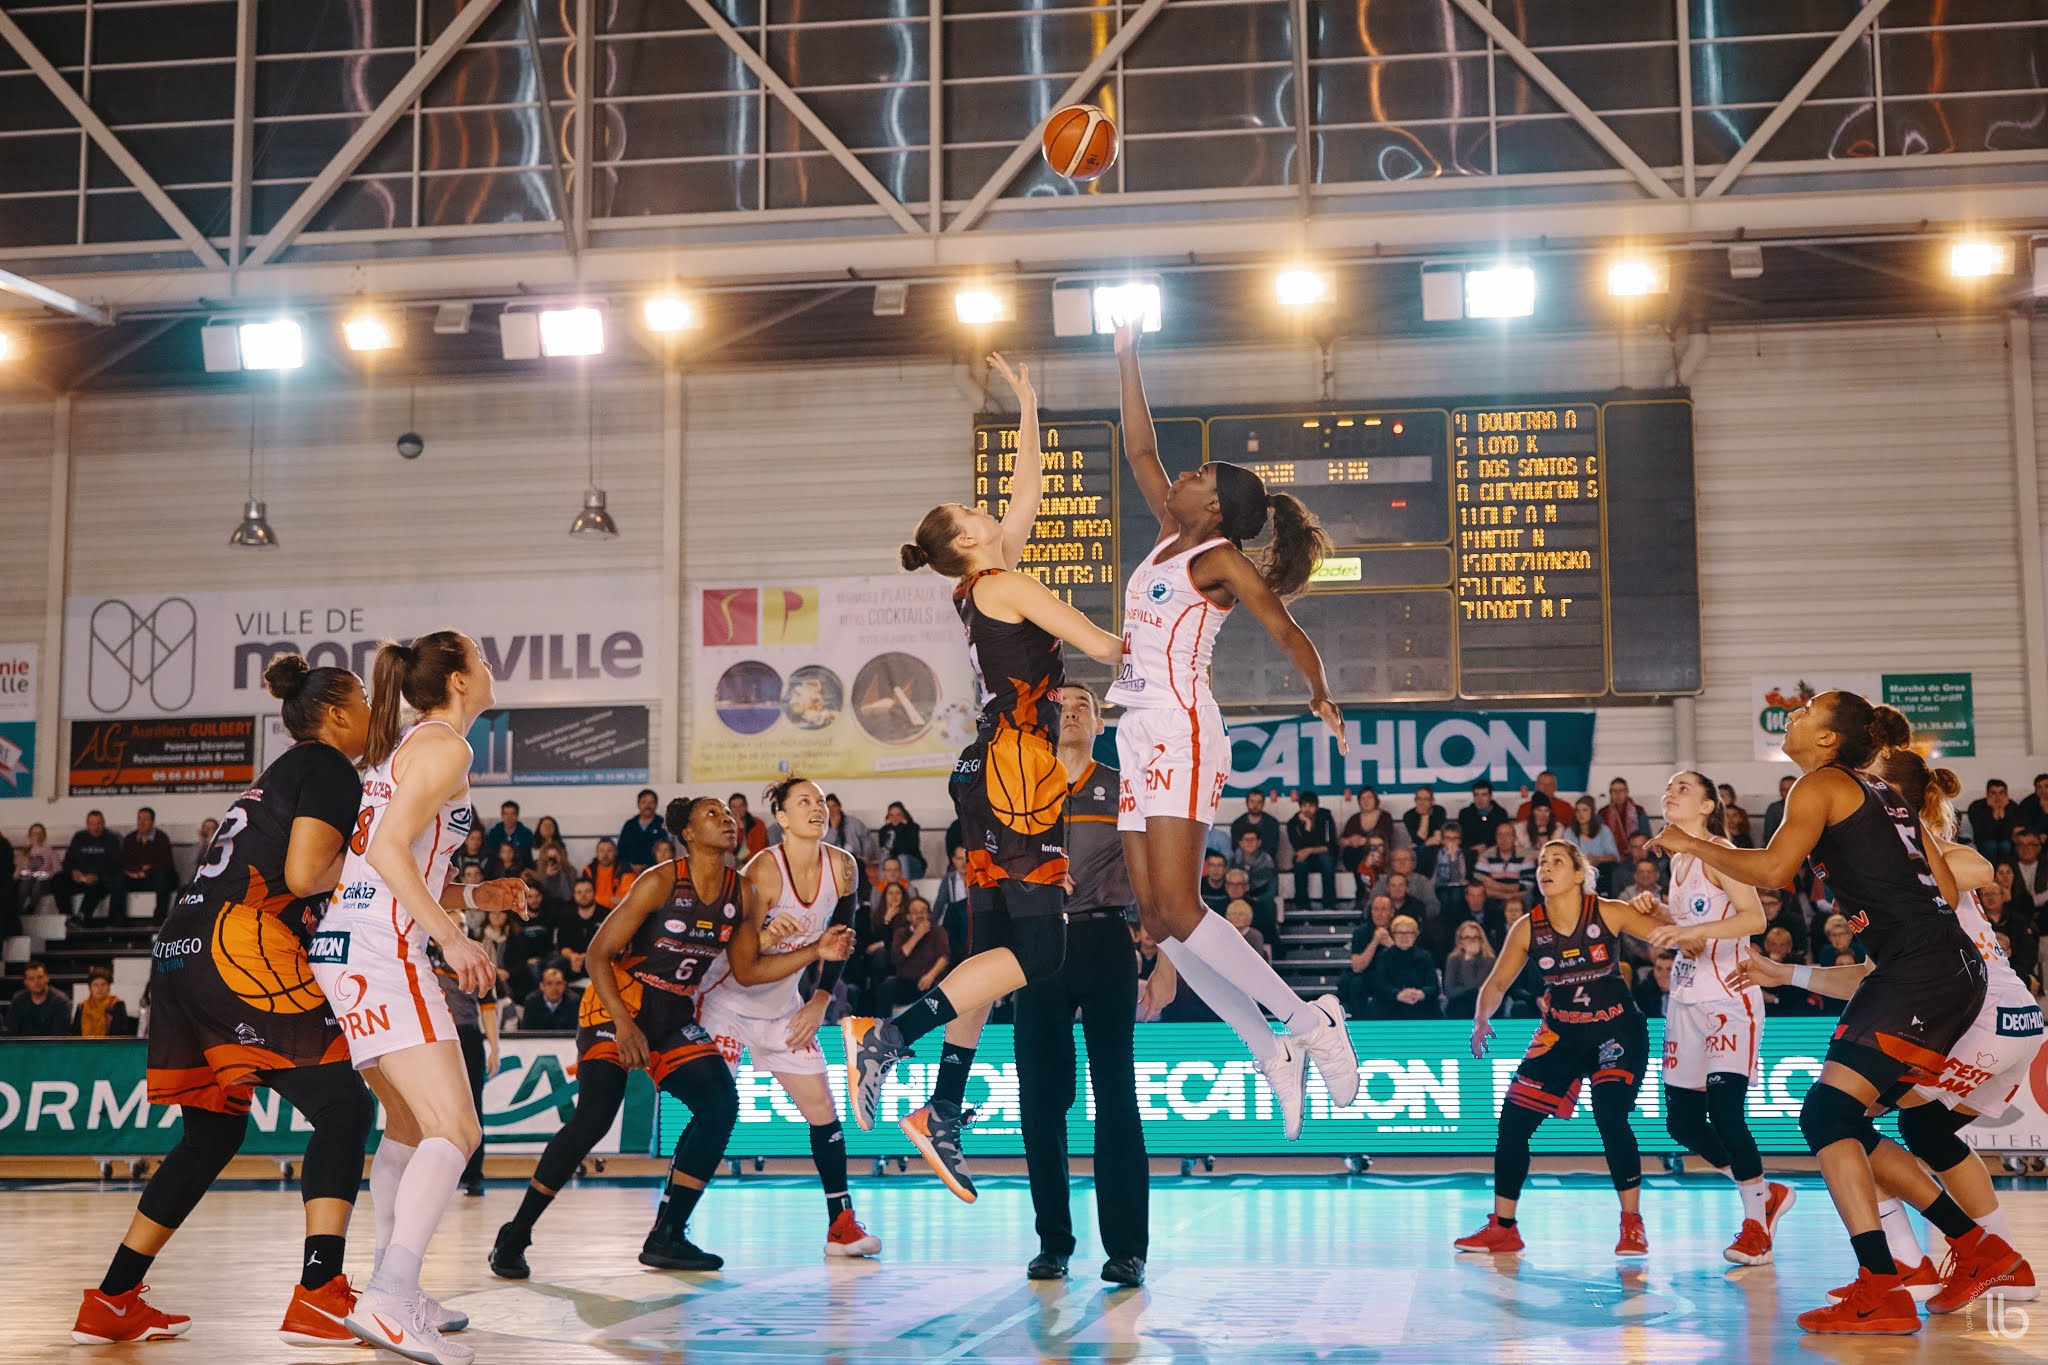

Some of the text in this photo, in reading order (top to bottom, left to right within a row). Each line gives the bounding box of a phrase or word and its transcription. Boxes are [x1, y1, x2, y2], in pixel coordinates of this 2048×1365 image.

[235, 608, 364, 636] VILLE DE
[1928, 683, 1940, 692] de
[1942, 682, 1966, 692] Gros
[188, 721, 253, 737] GUILBERT
[1230, 718, 1548, 789] CATHLON
[350, 805, 375, 857] 8
[675, 958, 698, 981] 6
[1572, 986, 1591, 1007] 4
[1550, 1003, 1625, 1024] NISSAN
[1086, 1058, 1461, 1121] ECATHLON
